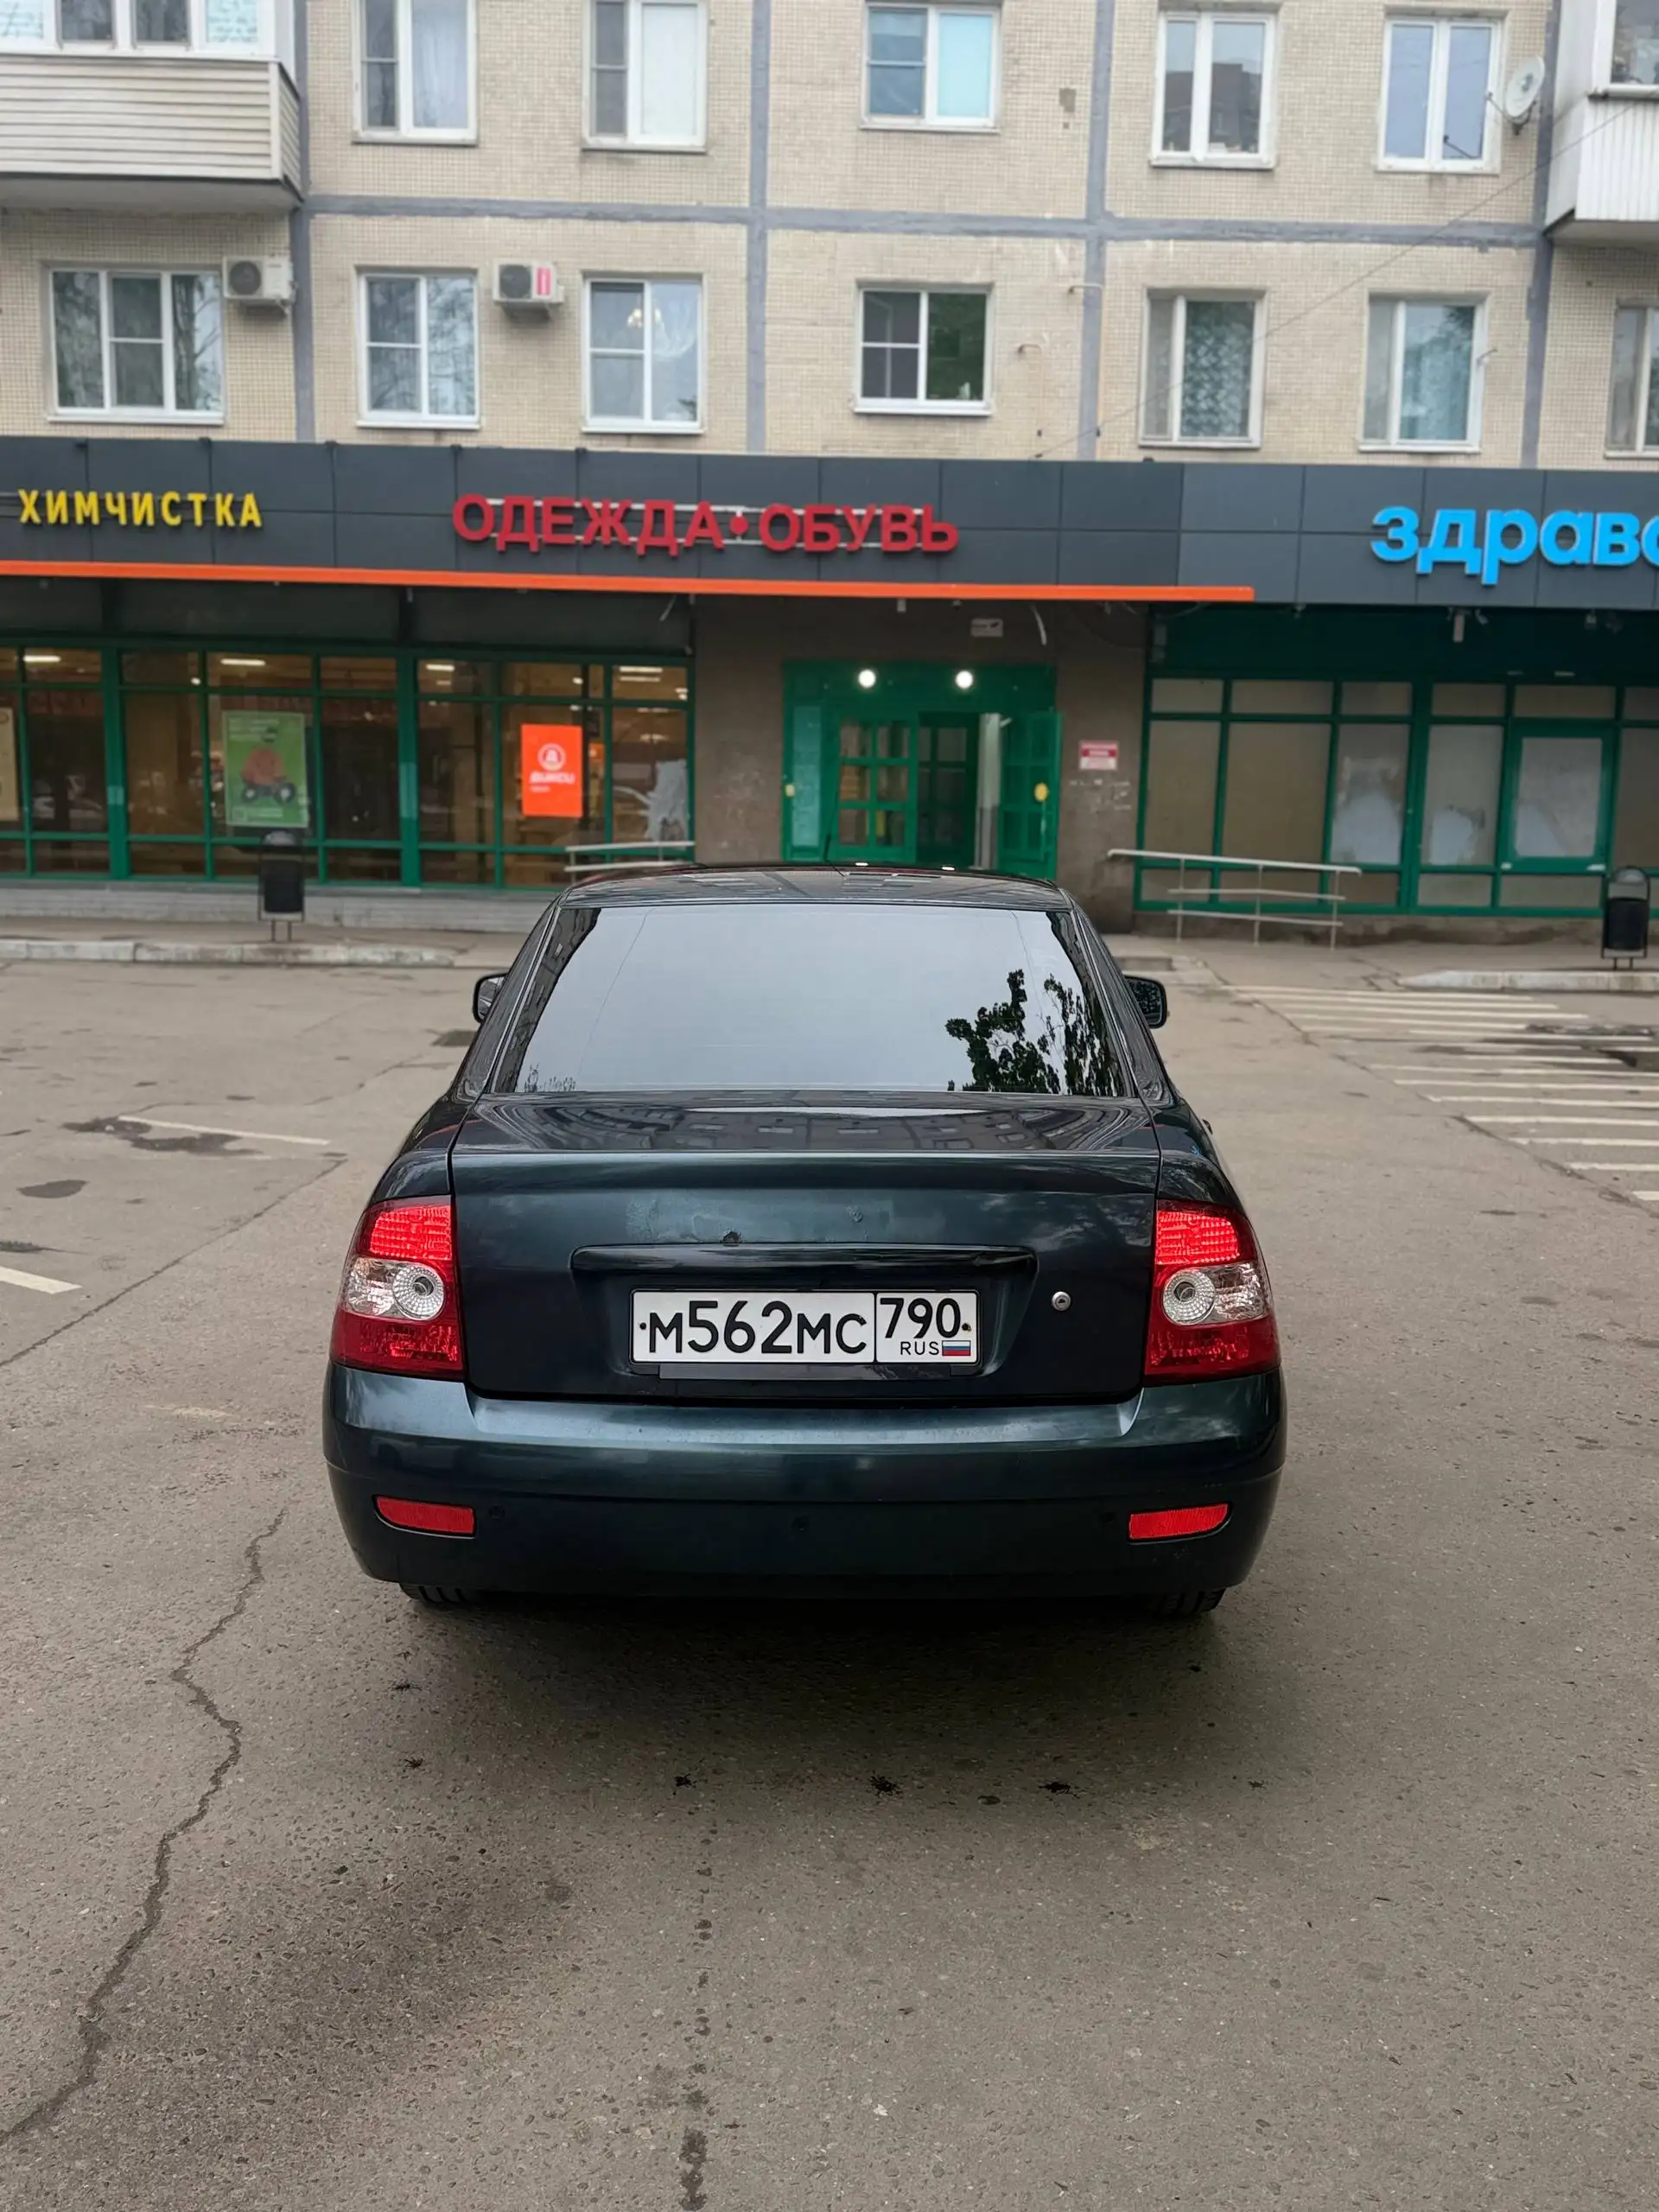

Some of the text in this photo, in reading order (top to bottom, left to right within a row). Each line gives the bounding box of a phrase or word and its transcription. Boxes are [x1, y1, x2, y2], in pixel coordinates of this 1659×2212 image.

[17, 489, 263, 528] ХИМЧИСТКА
[452, 493, 958, 556] ОДЕЖДА ОБУВЬ
[649, 1298, 962, 1354] М562МС 790
[899, 1341, 940, 1356] RUS
